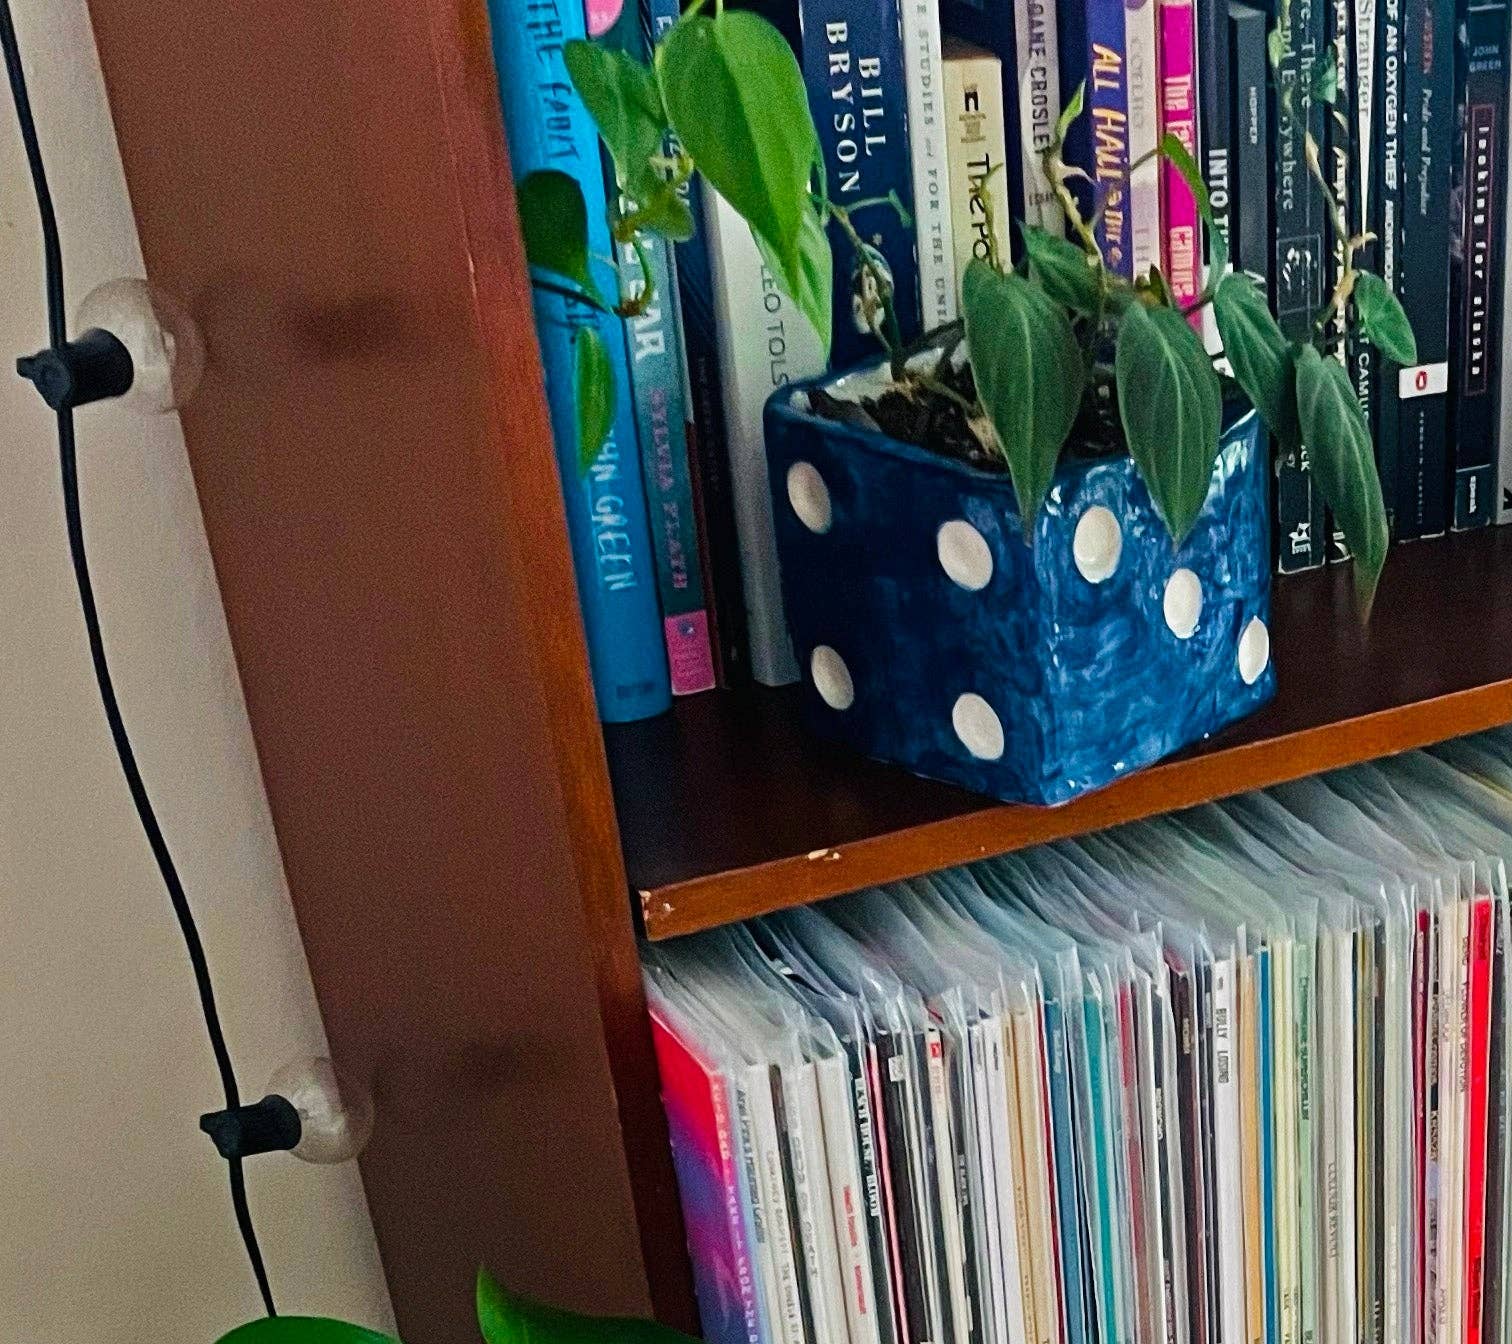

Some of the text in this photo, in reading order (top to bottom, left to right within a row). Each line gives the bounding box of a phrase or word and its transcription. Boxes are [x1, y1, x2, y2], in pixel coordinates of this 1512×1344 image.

[526, 0, 563, 64] THE
[1385, 24, 1399, 54] AN
[918, 30, 934, 126] STUDIES
[1092, 43, 1123, 93] ALL
[1164, 74, 1194, 111] The
[1384, 55, 1399, 136] OXYGEN
[825, 21, 862, 194] BRYSON
[857, 56, 887, 158] BILL
[1279, 68, 1300, 211] Erywhere
[1092, 105, 1129, 184] HAIL
[1207, 147, 1229, 208] INTO
[1384, 138, 1398, 191] THIEF
[927, 168, 939, 211] FOR
[932, 224, 944, 265] THE
[1471, 125, 1492, 376] looking for alaska
[592, 495, 638, 592] GREEN
